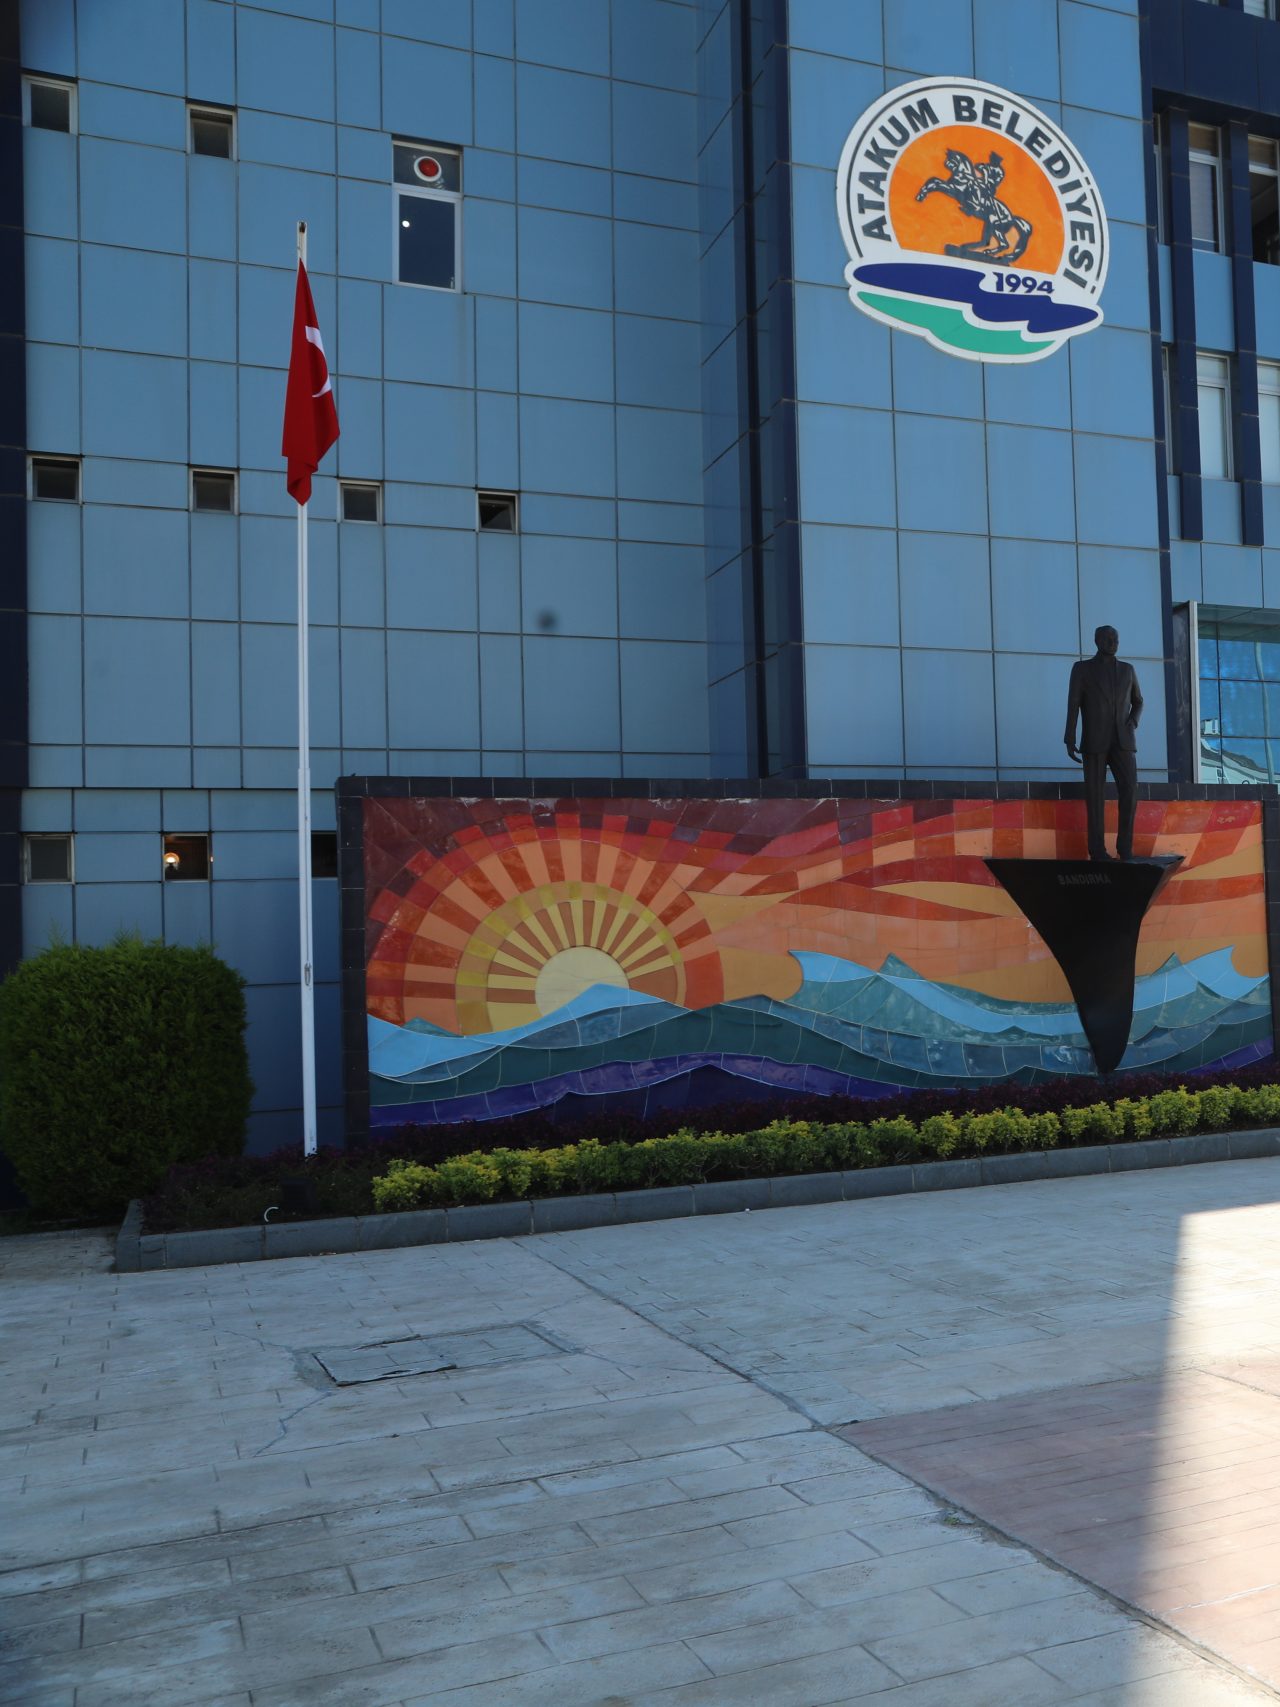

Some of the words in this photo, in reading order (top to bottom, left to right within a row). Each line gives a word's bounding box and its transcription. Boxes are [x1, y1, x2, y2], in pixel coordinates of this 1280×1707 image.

[857, 98, 940, 243] ATAKUM
[951, 94, 1096, 295] BELEDİYESİ
[992, 272, 1055, 294] 1994
